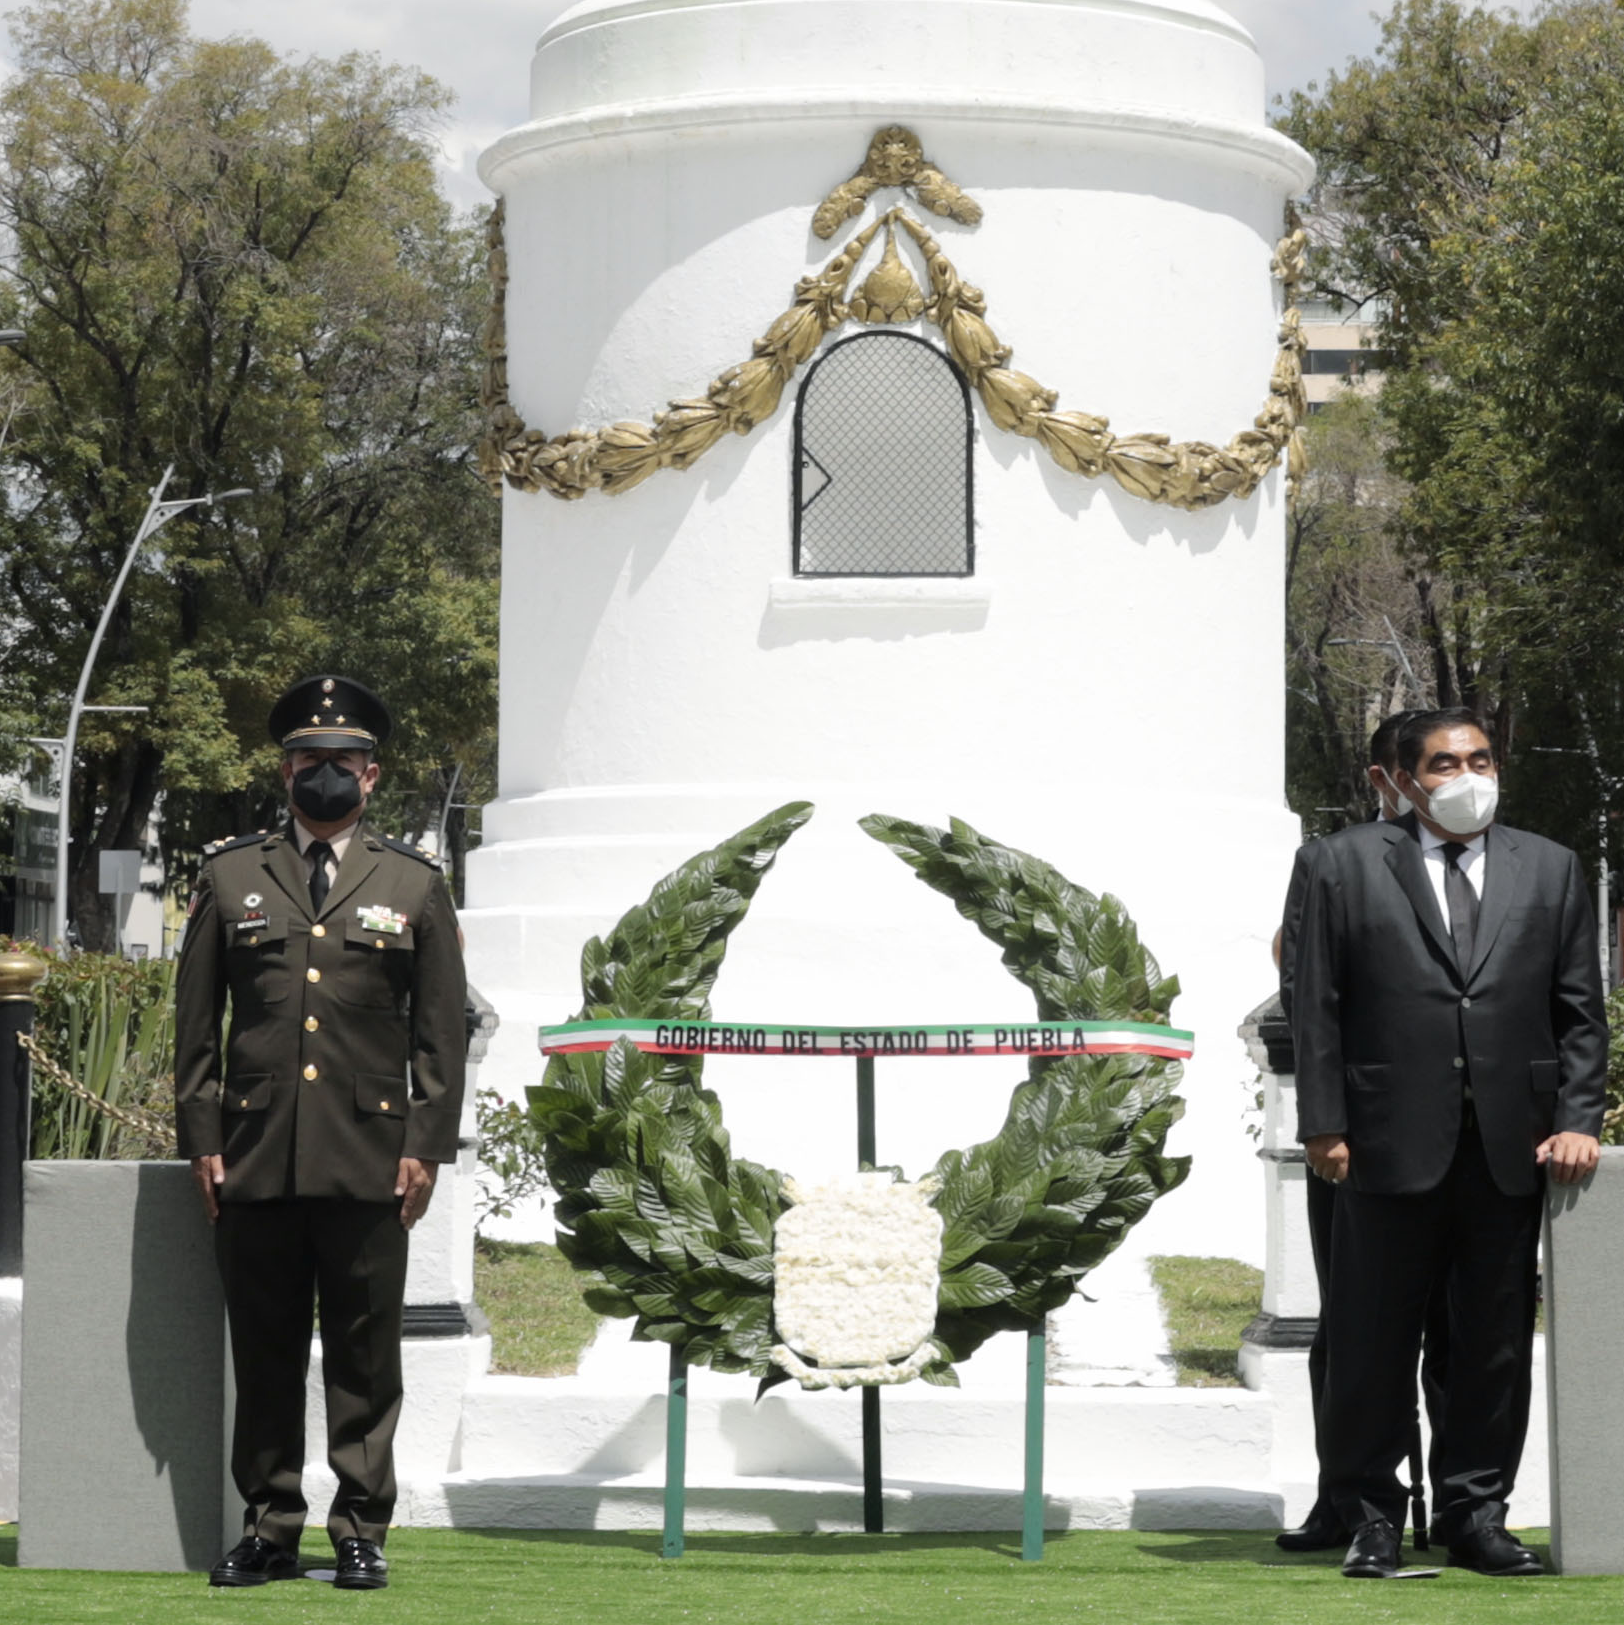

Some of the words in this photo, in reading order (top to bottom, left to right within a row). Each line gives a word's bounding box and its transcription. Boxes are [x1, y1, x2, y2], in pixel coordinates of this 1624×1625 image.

[656, 1025, 766, 1052] GOBIERNO
[782, 1030, 823, 1054] DEL
[840, 1030, 928, 1055] ESTADO
[947, 1029, 974, 1054] DE
[994, 1026, 1086, 1053] PUEBLA
